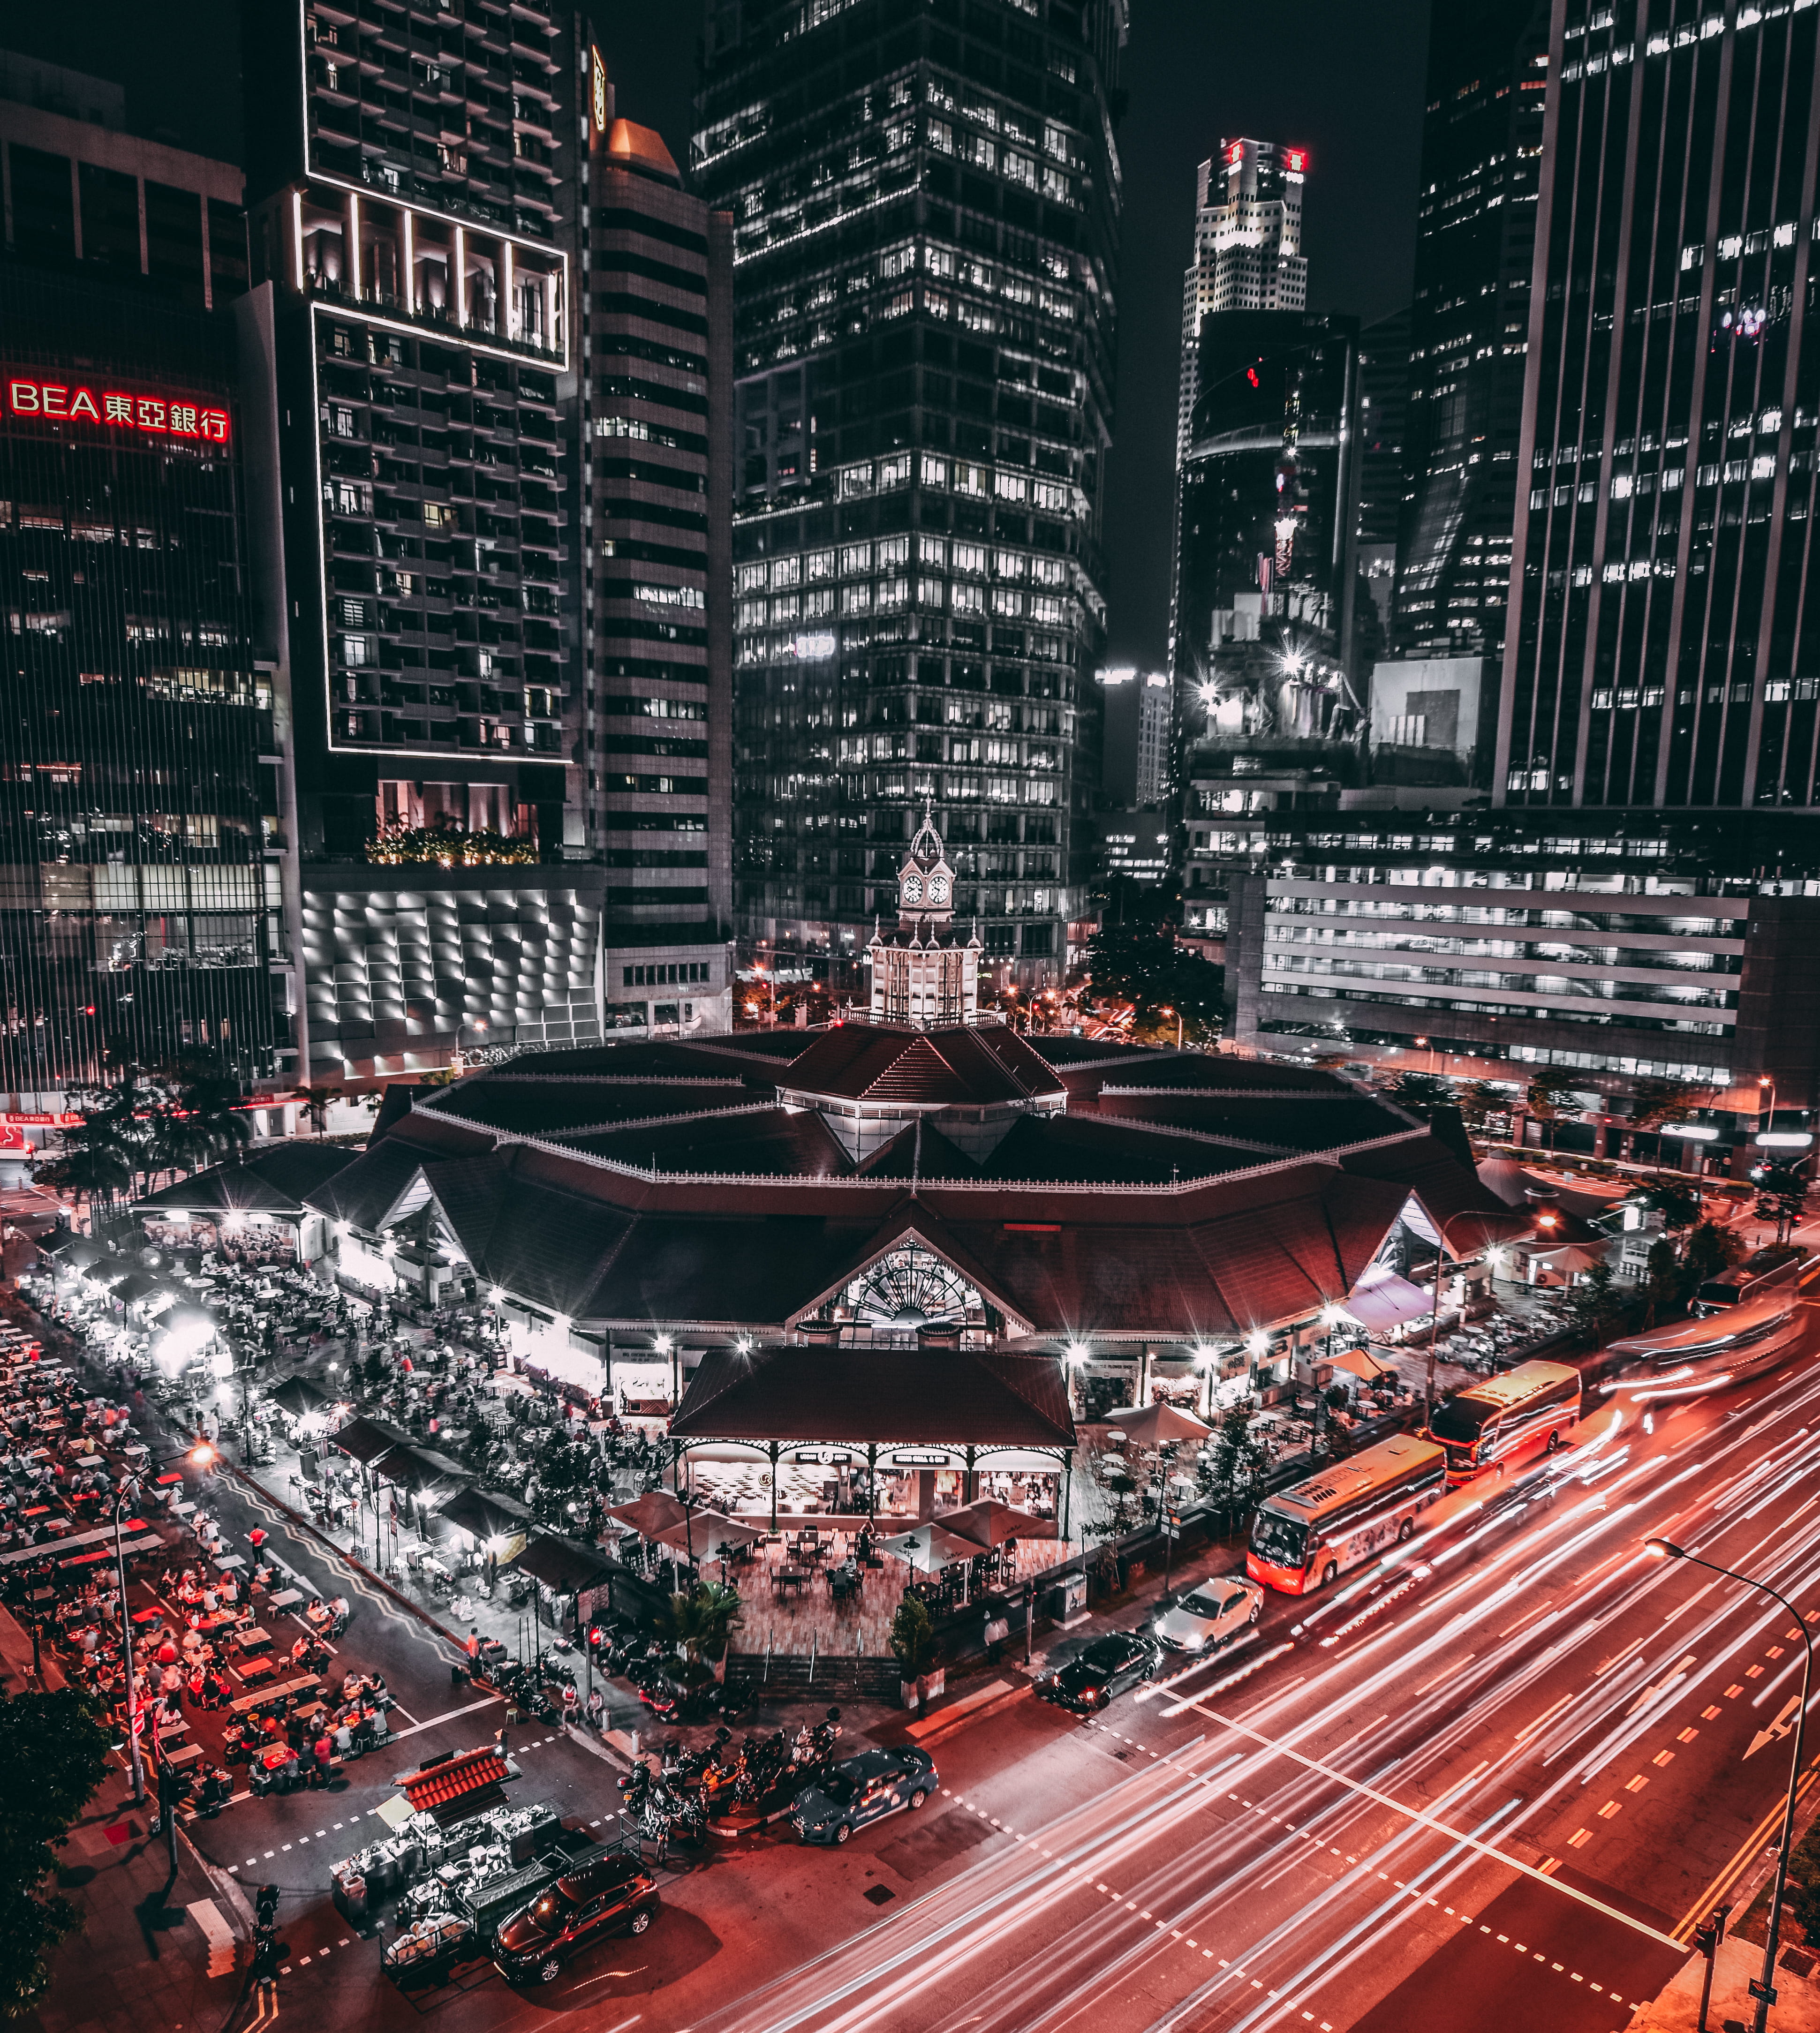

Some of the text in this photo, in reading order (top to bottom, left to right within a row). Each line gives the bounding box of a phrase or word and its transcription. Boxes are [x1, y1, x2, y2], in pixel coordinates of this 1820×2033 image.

[12, 383, 227, 438] BEA 東亞銀行
